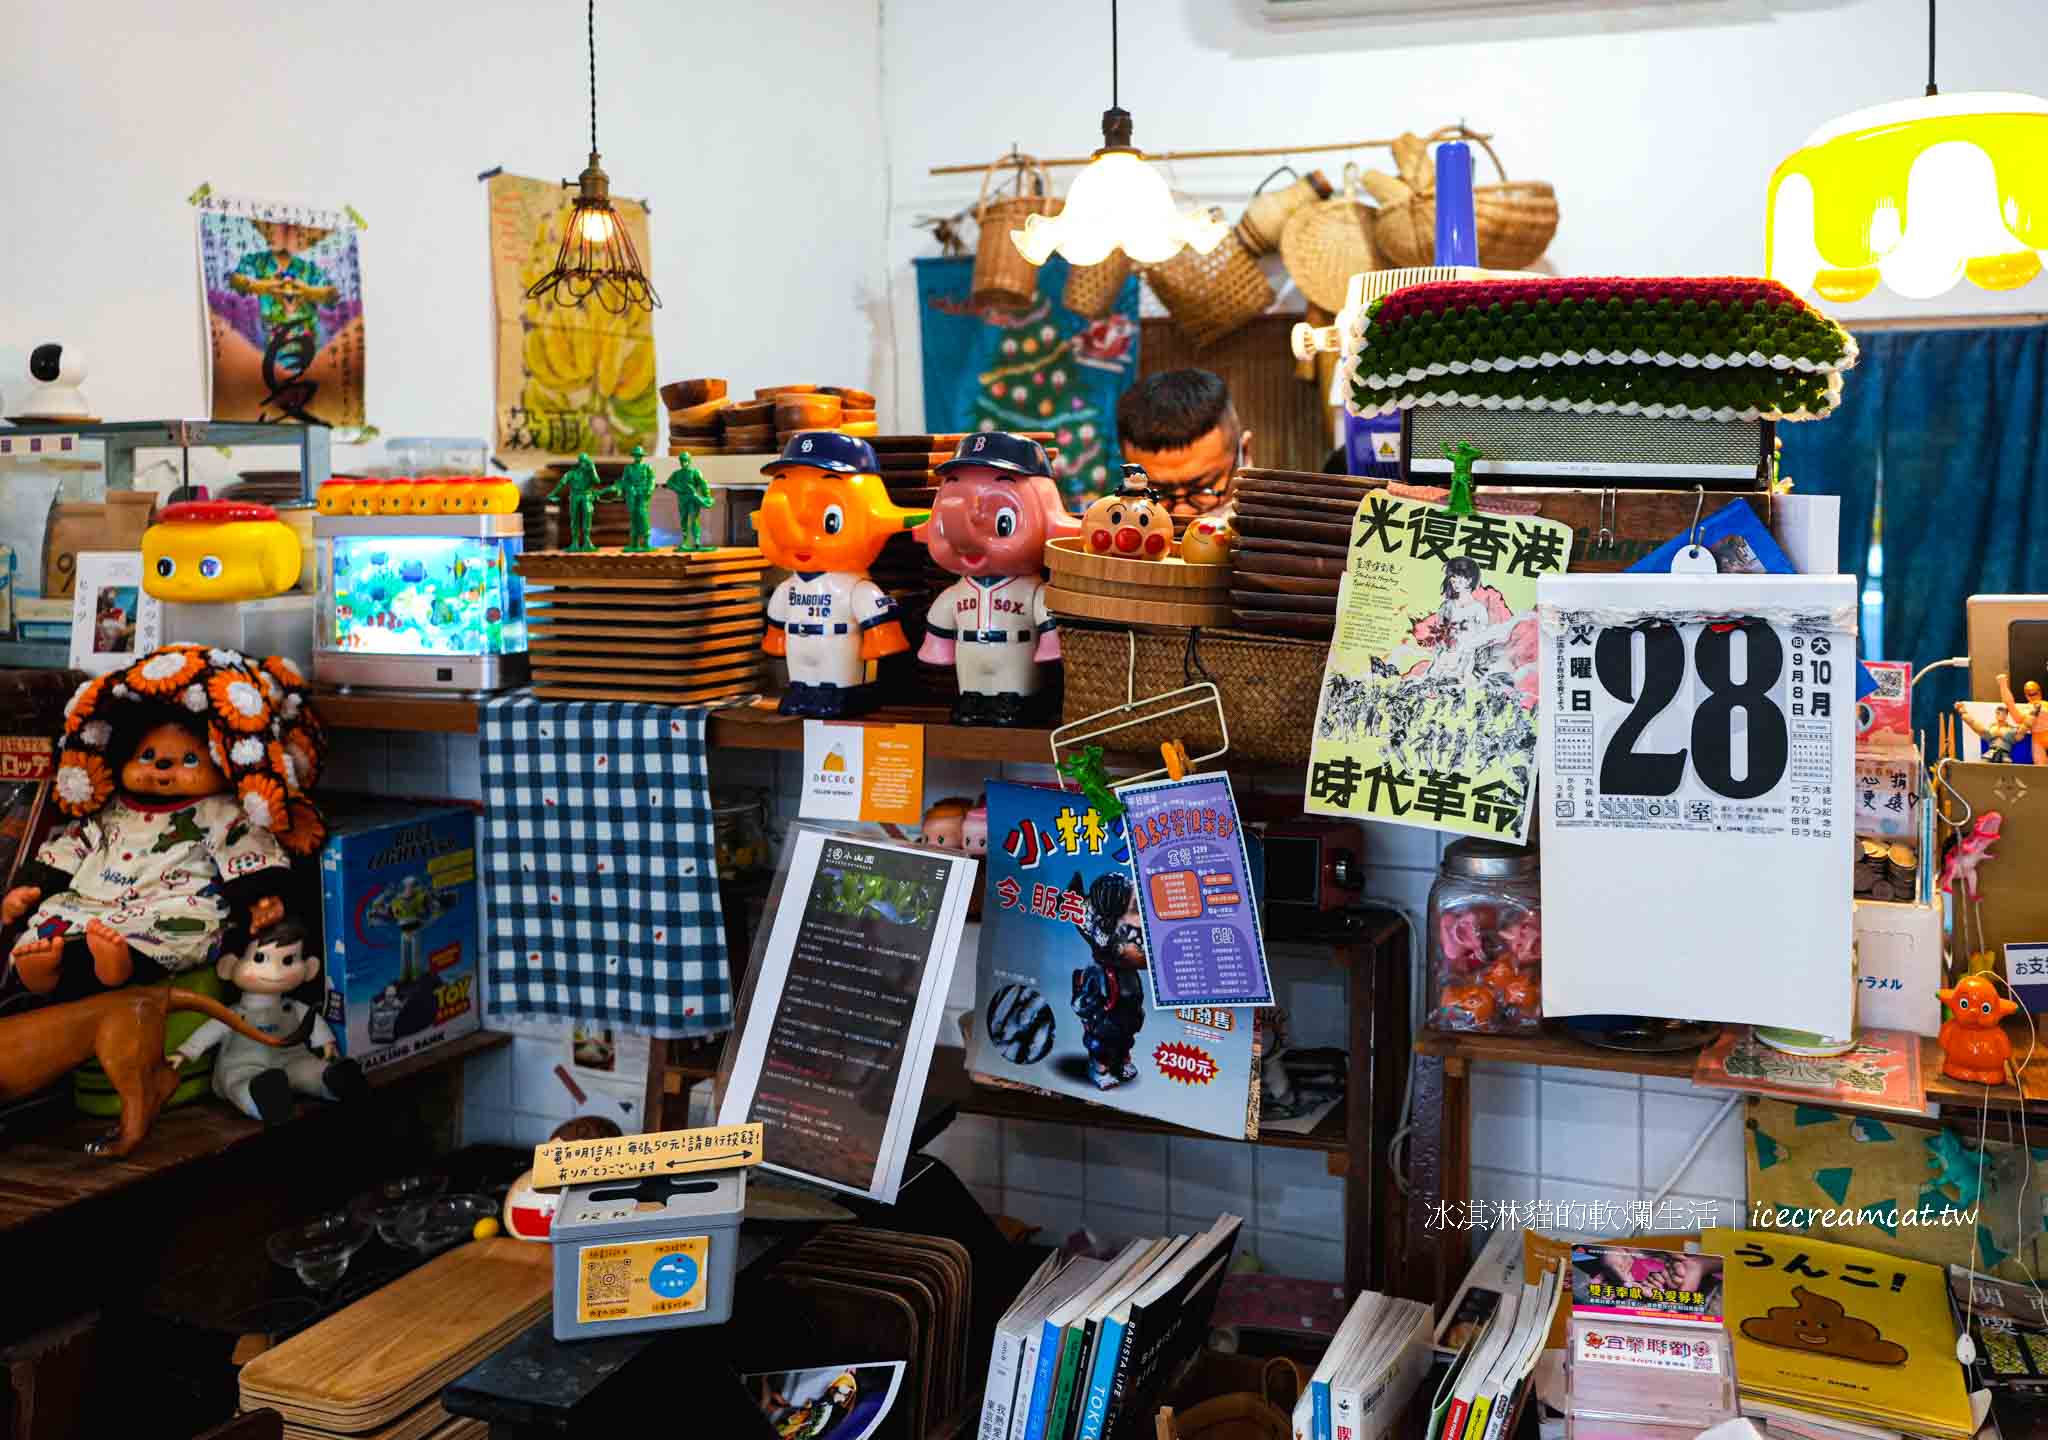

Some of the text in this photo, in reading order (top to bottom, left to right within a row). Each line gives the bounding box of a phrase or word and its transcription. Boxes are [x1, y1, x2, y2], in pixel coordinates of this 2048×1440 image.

[1355, 496, 1565, 579] 光復香港
[788, 588, 832, 606] DRAGONS
[957, 599, 977, 613] RED
[1595, 616, 1788, 799] 28
[1310, 755, 1521, 835] 時代革命
[995, 876, 1087, 926] 今、販売
[2015, 955, 2048, 976] お支
[434, 976, 472, 1007] TOY
[1857, 976, 1903, 990] ラメル
[1159, 1050, 1212, 1077] 2300元
[1113, 1320, 1136, 1398] BARISTA LIFE
